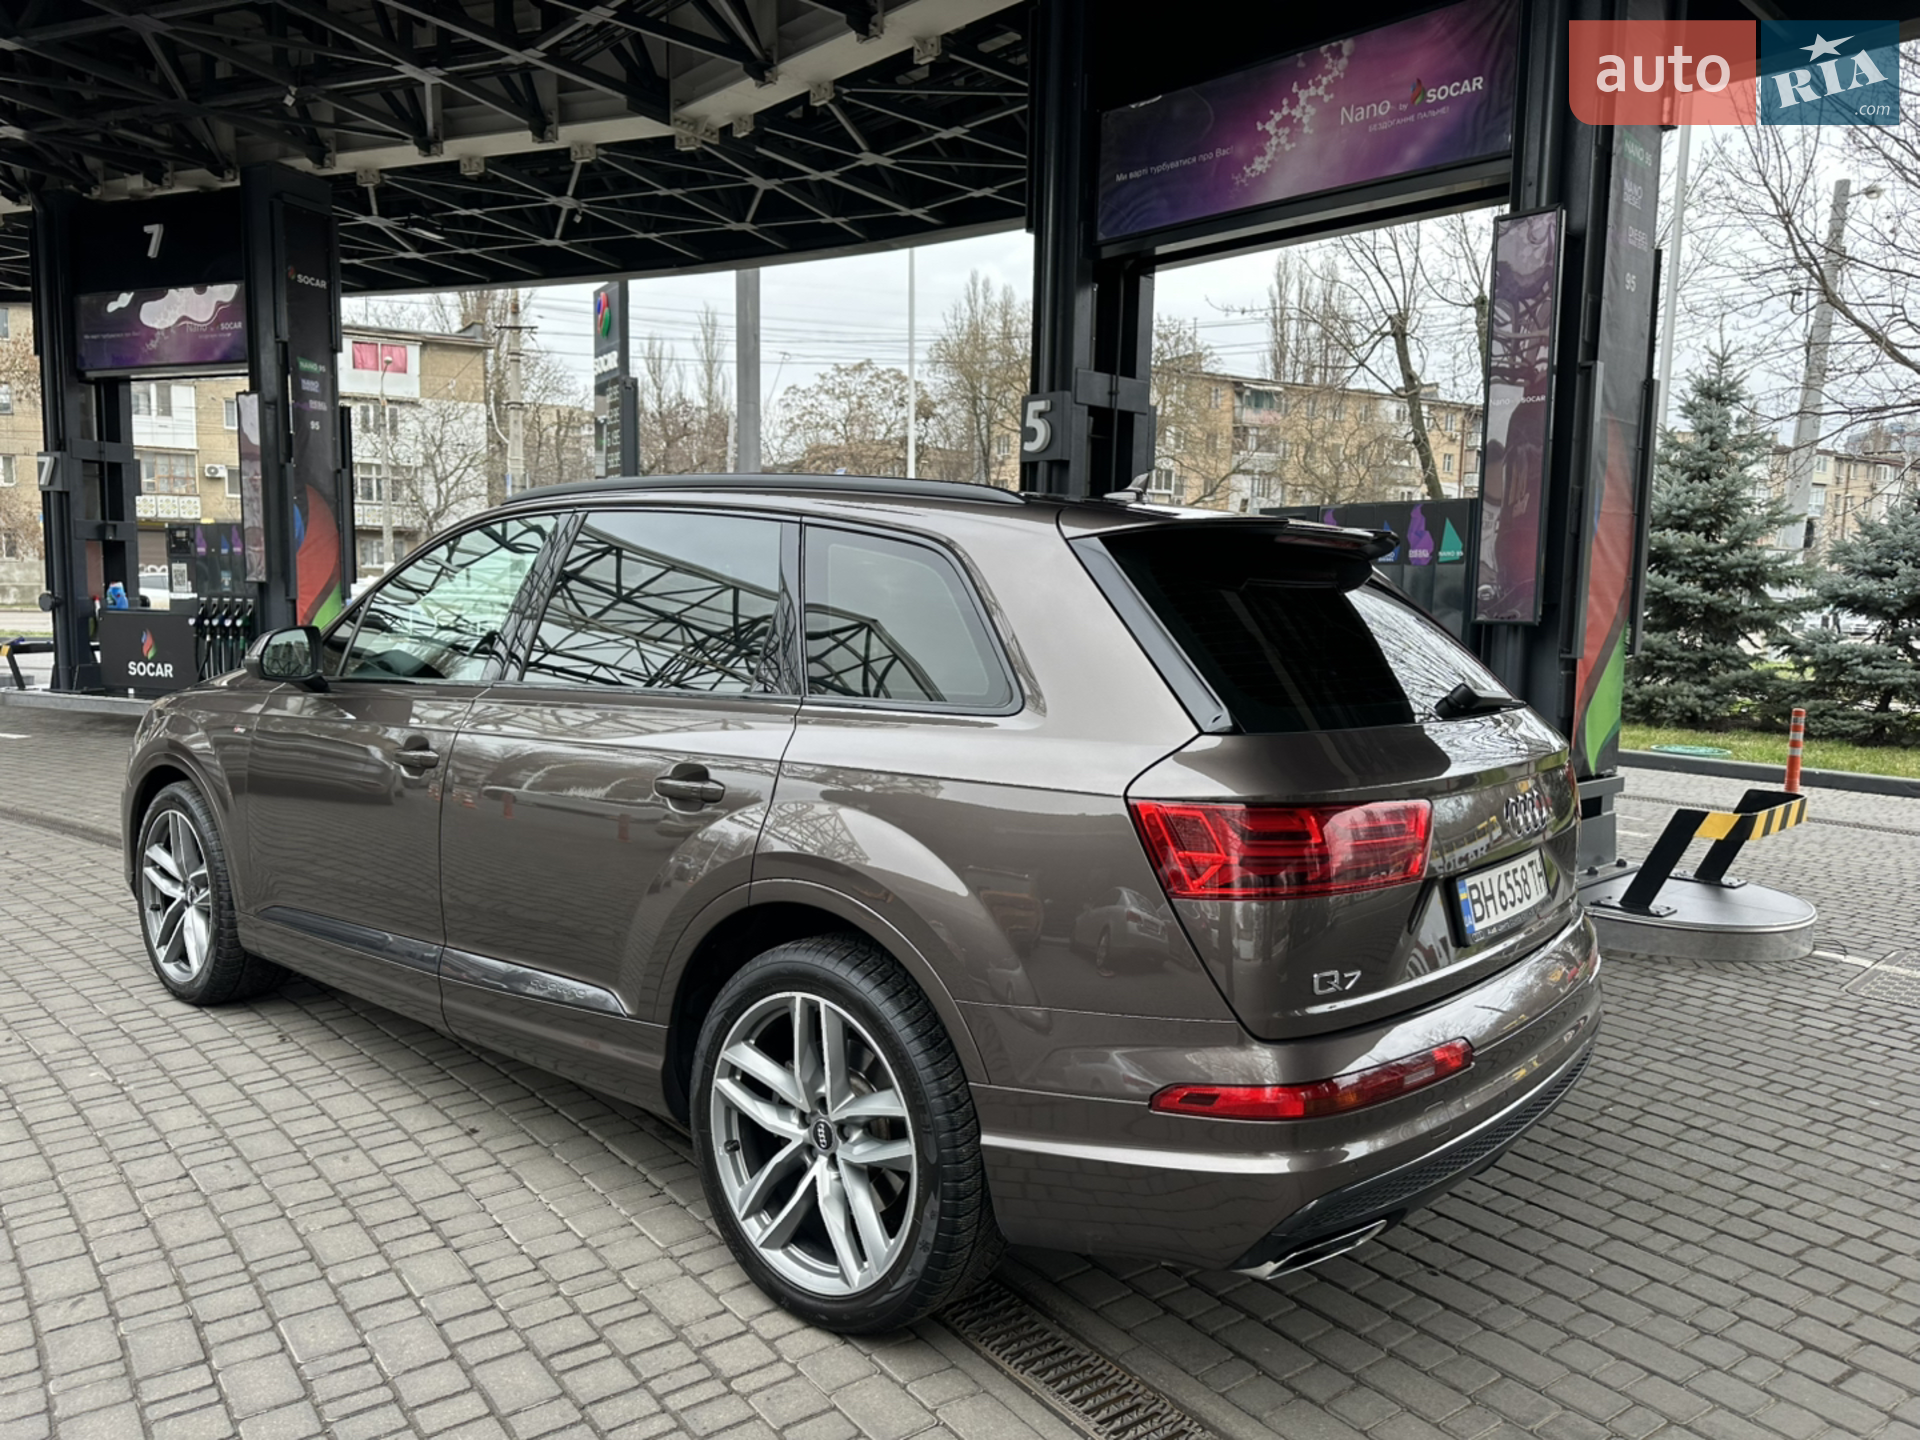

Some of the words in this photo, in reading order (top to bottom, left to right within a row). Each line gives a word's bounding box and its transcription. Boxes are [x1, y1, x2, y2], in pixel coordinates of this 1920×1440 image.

[1340, 100, 1391, 125] Nano
[1399, 103, 1409, 112] by
[1425, 76, 1484, 104] SOCAR
[1368, 115, 1415, 133] БЕЗДОГАННЕ
[1624, 139, 1644, 161] NANO
[1115, 173, 1127, 182] Ми
[1150, 156, 1197, 175] турбуватися
[1198, 151, 1214, 163] про
[143, 223, 164, 258] 7
[296, 274, 328, 289] SOCAR
[1625, 272, 1636, 292] 95
[220, 321, 243, 331] SOCAR
[310, 420, 320, 430] 95
[1023, 400, 1052, 453] 5
[37, 456, 56, 486] 7
[128, 660, 174, 678] SOCAR
[1468, 877, 1499, 924] BH
[1497, 864, 1532, 912] 6558
[1313, 970, 1362, 996] Q7
